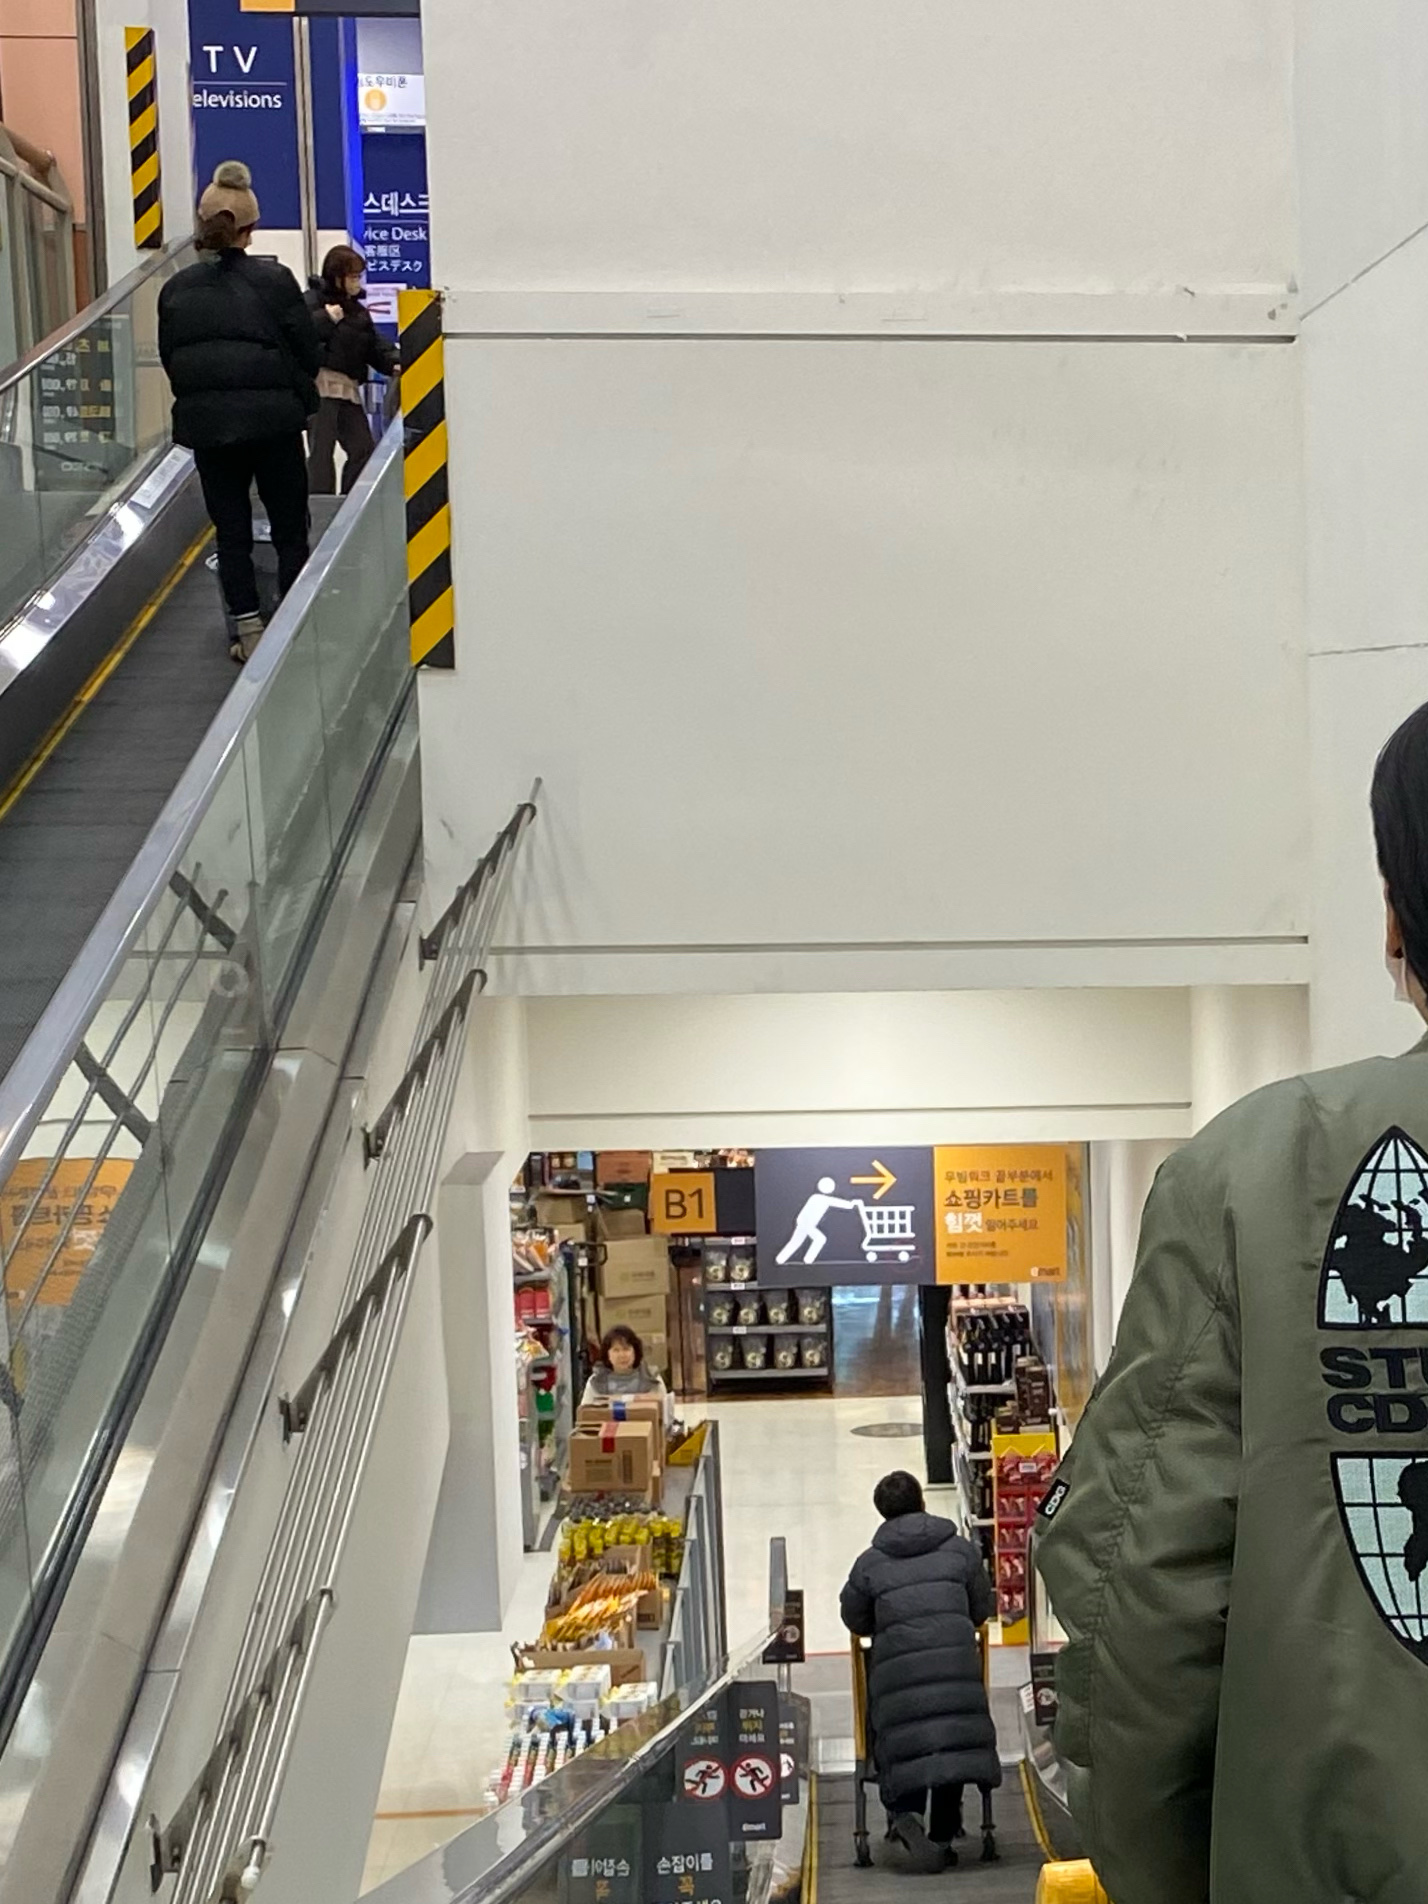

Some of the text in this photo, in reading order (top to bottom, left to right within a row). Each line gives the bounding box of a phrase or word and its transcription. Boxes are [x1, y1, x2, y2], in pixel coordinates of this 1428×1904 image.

[202, 46, 257, 73] TV
[391, 226, 427, 241] Desk
[665, 1188, 705, 1219] B1
[944, 1187, 1038, 1209] 쇼핑카트를
[944, 1211, 983, 1234] 힘껏
[1044, 1485, 1066, 1515] CDG
[656, 1852, 713, 1875] 손잡이를
[678, 1877, 695, 1896] 꼭
